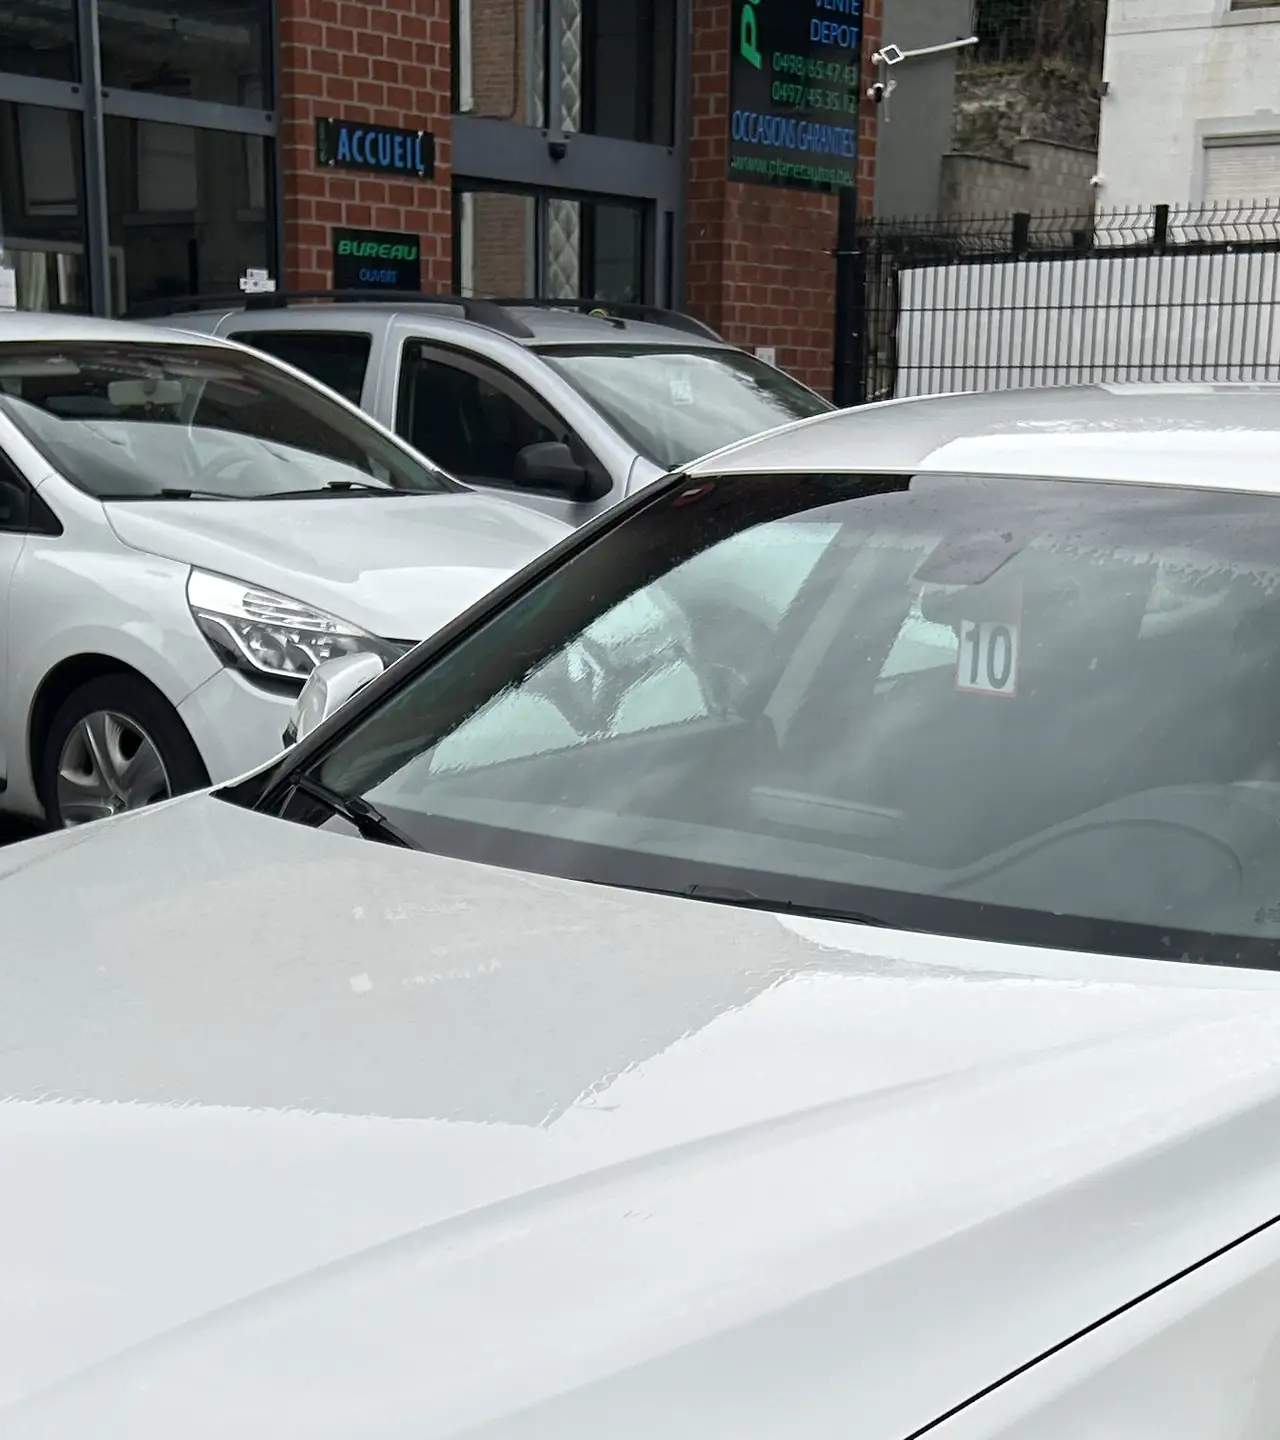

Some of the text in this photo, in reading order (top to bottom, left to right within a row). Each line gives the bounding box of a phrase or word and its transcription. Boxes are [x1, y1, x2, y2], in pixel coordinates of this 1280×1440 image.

[810, 18, 860, 49] DEPOT
[337, 128, 425, 170] ACCUEIL
[337, 239, 417, 261] BUREAU
[964, 624, 1013, 690] 10
